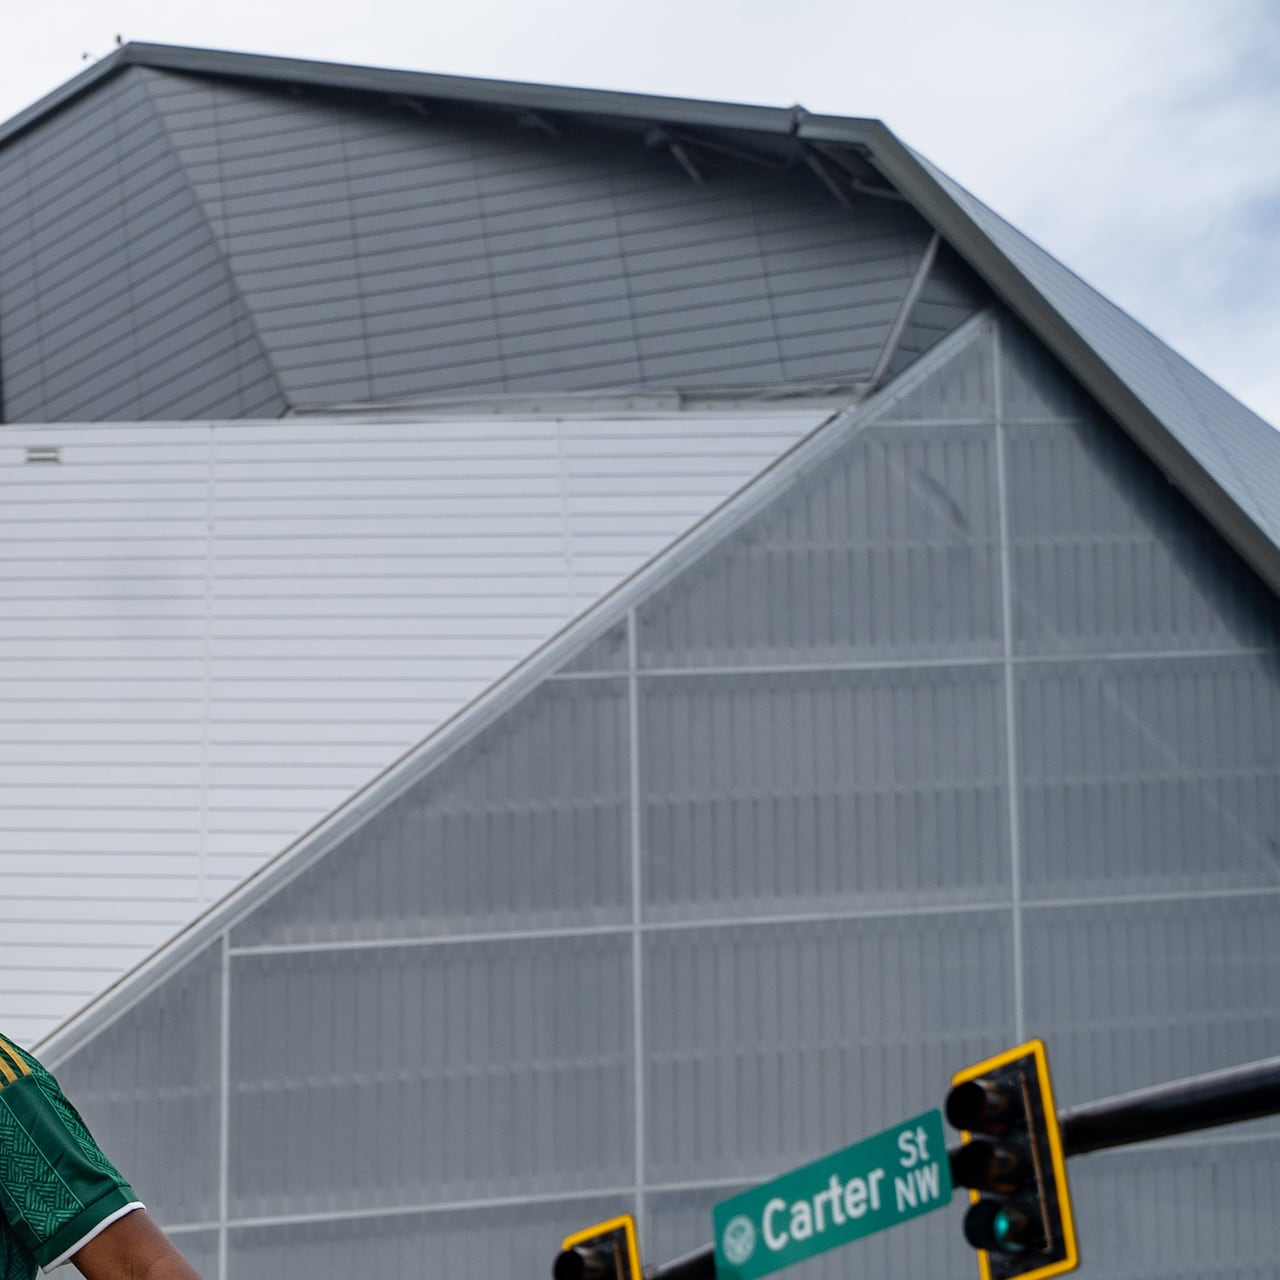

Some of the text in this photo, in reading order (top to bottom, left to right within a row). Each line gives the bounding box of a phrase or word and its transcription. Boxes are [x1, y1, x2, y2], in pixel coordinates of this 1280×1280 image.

[898, 1127, 929, 1167] St
[763, 1168, 884, 1250] Carter
[894, 1162, 940, 1213] NW
